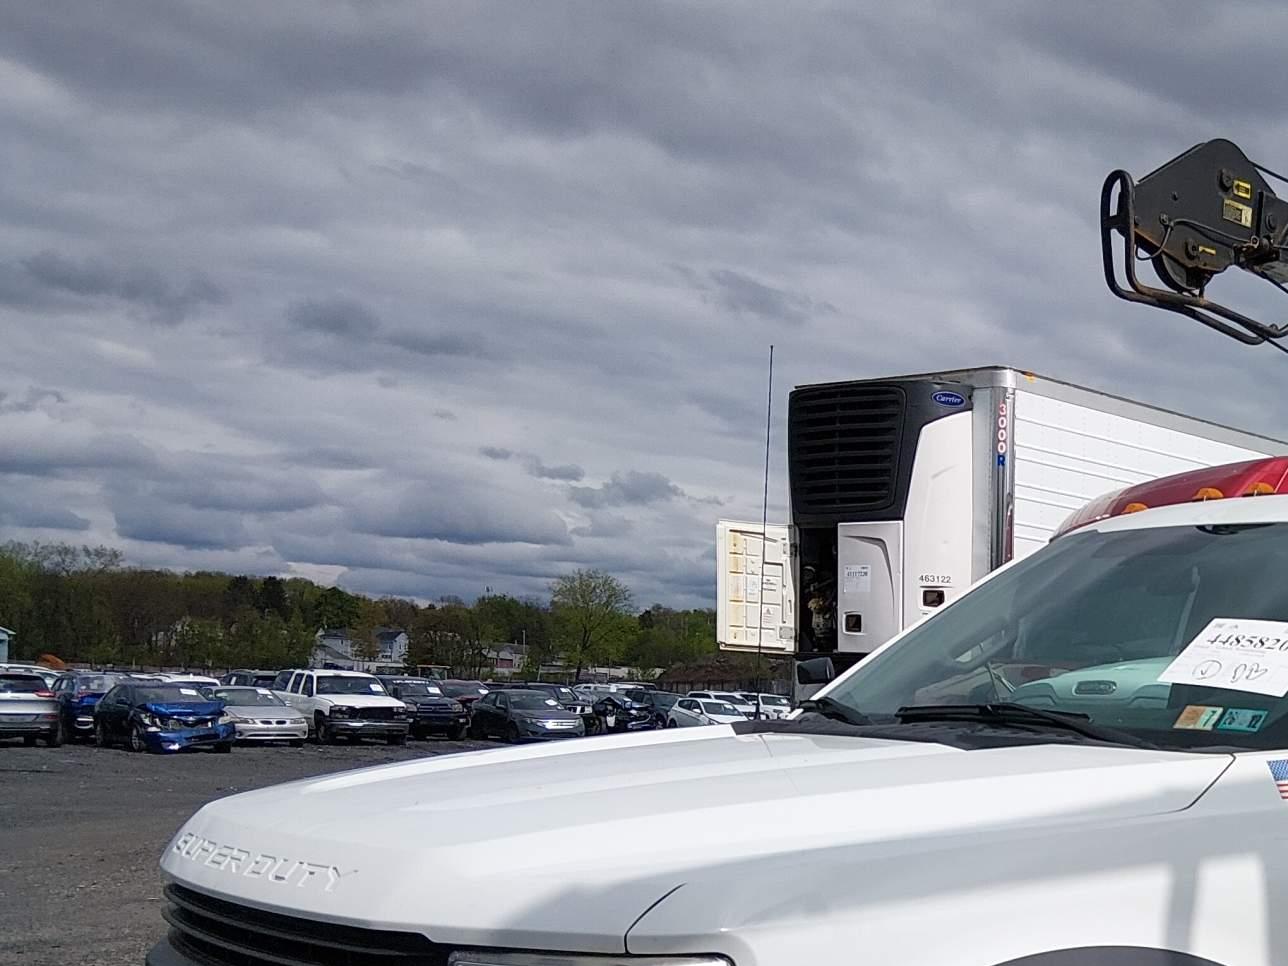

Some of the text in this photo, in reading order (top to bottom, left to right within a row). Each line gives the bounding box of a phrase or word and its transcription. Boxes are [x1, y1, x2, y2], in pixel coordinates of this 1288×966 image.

[936, 394, 961, 404] Carrier
[919, 574, 952, 584] 463122
[175, 832, 352, 892] SUPER DUTY
